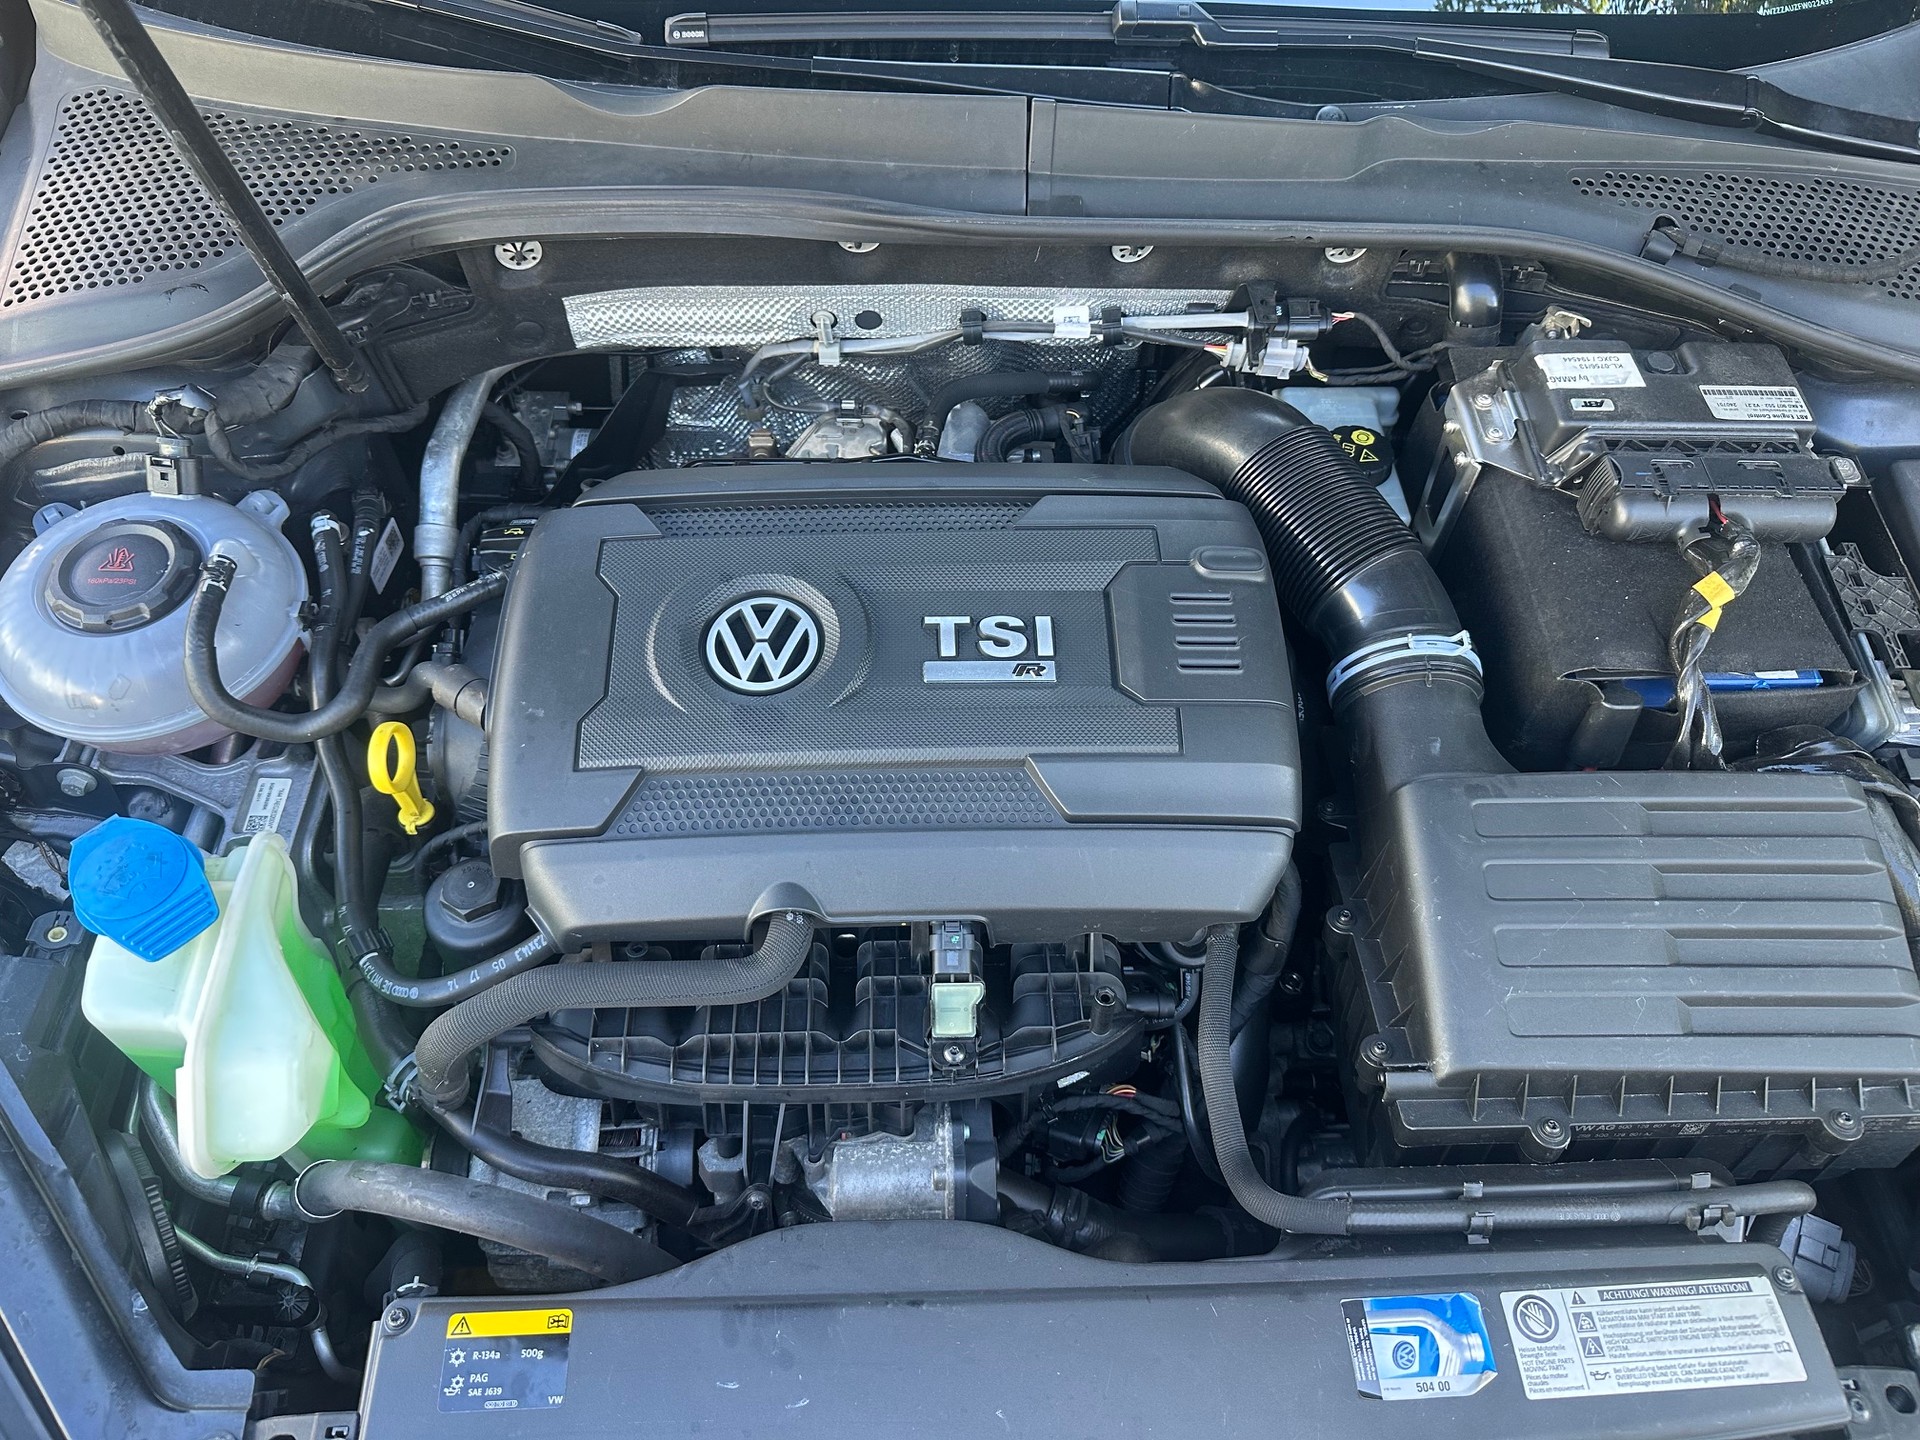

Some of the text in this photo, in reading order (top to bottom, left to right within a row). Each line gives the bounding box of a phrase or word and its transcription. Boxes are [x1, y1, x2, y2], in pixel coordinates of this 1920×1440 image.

[1578, 374, 1590, 382] by
[922, 616, 1056, 658] TSI
[1603, 1283, 1749, 1300] ACHTUNG! WARNING! ATTENTION!
[472, 1348, 544, 1360] R-134a 500g
[470, 1373, 488, 1383] PAG
[468, 1387, 502, 1396] SAE J639
[1416, 1381, 1450, 1393] 504 00
[548, 1395, 563, 1404] VW
